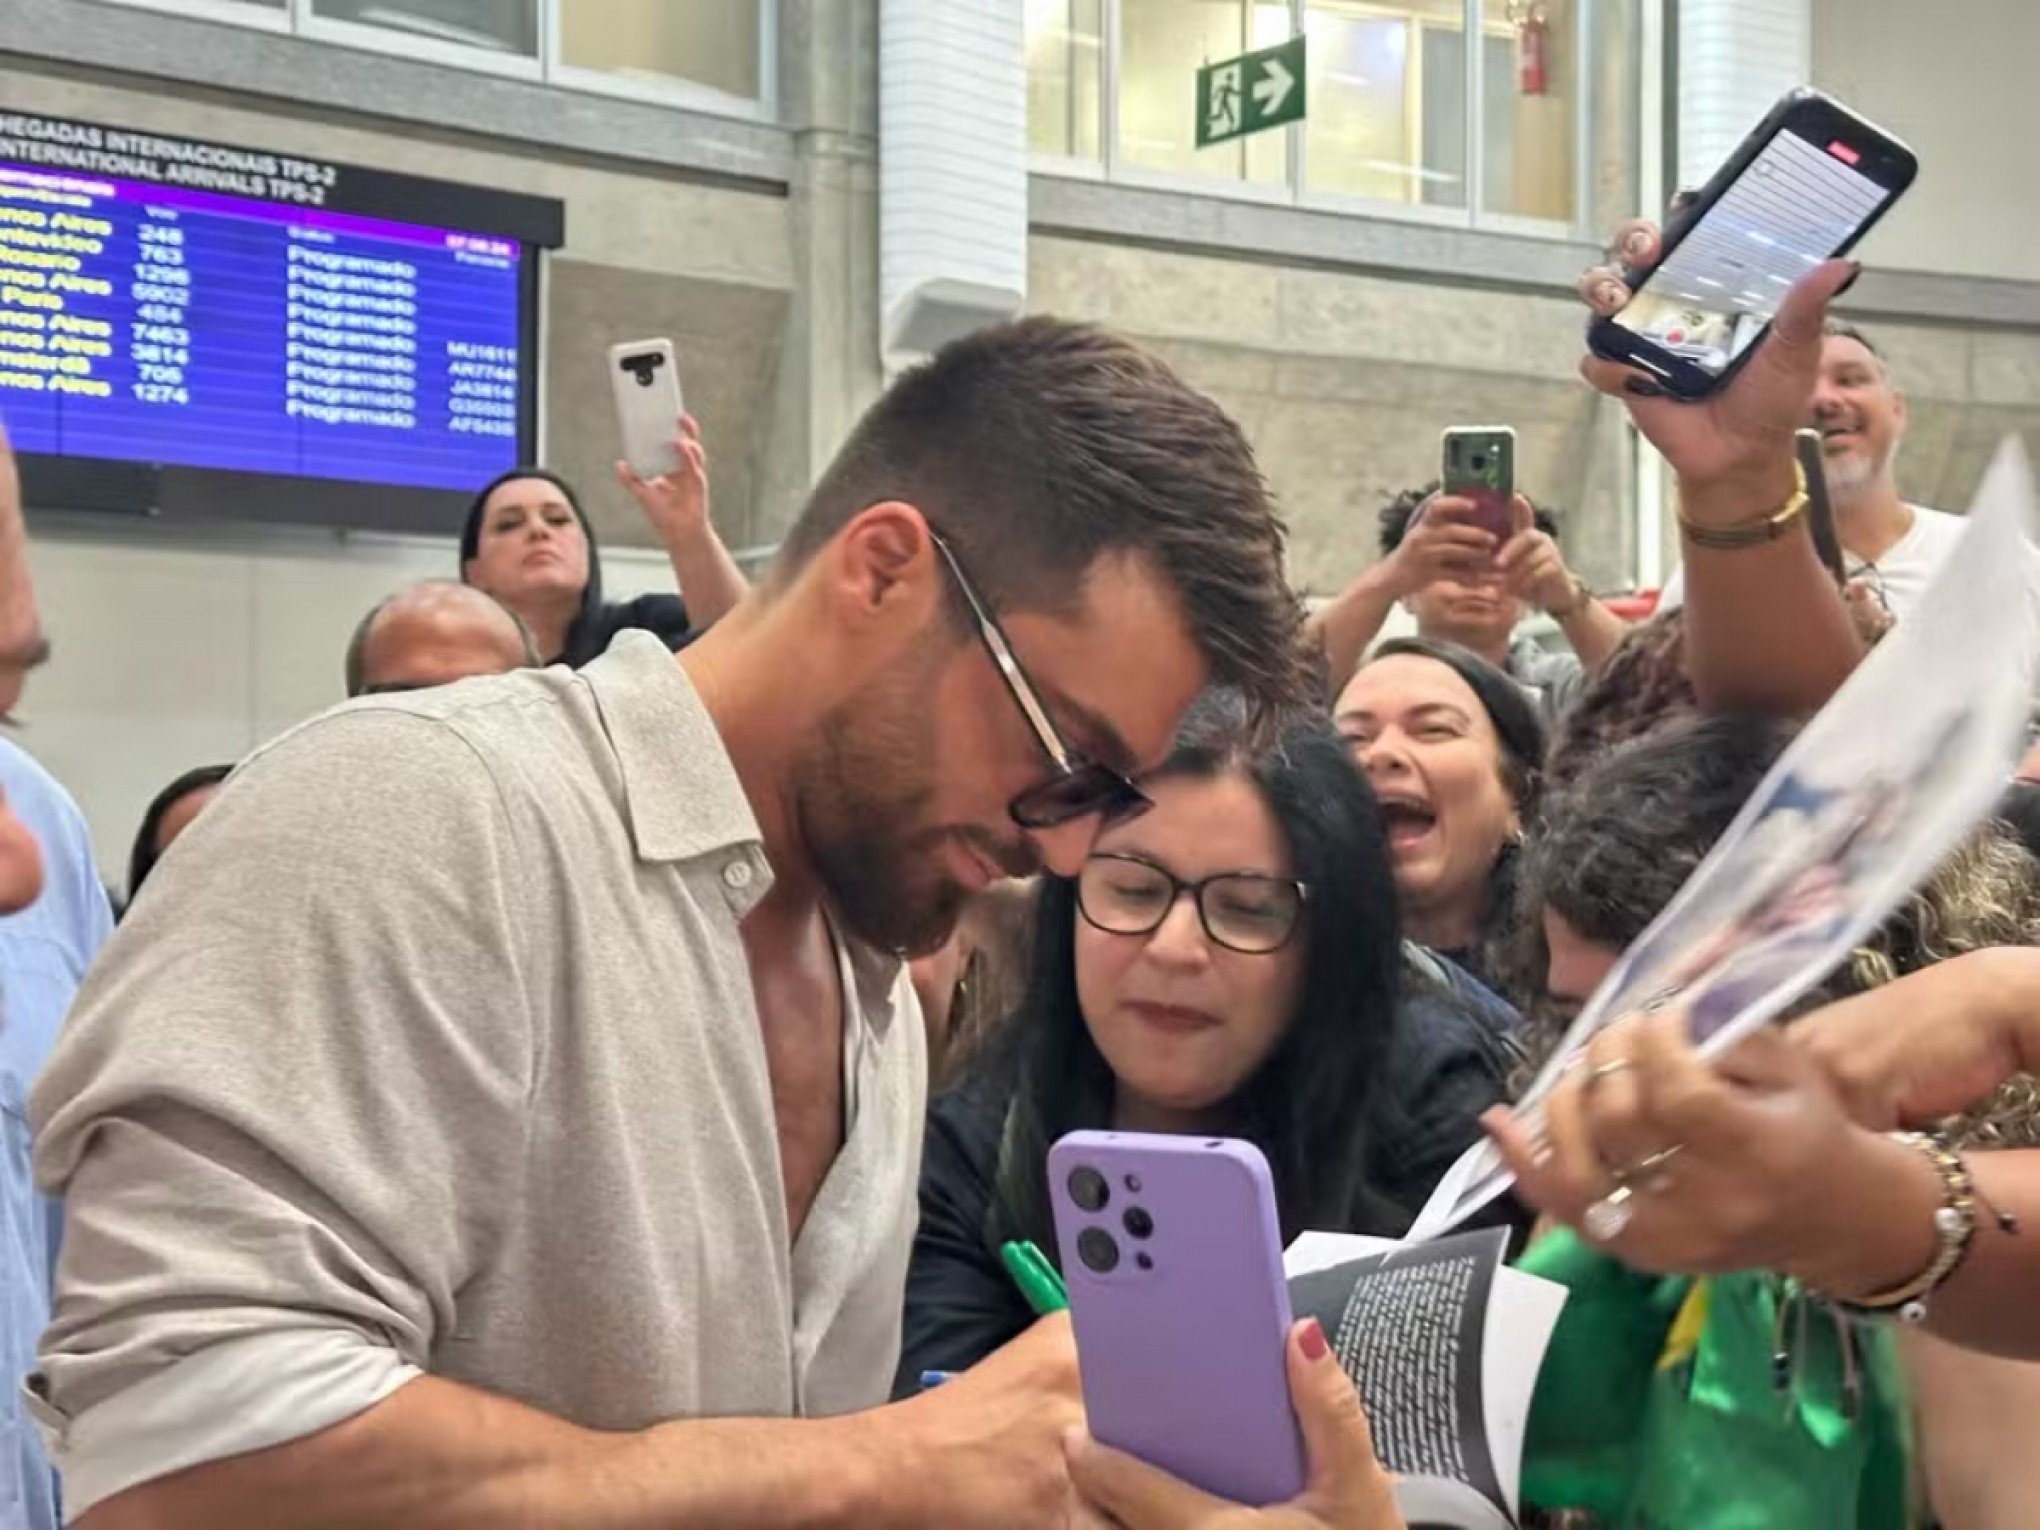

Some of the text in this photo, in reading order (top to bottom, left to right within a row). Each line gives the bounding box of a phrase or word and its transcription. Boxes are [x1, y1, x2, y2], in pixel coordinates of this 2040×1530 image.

[287, 245, 417, 278] Programado
[287, 264, 417, 297] Programado
[287, 284, 417, 317] Programado
[287, 303, 417, 335] Programado
[287, 322, 417, 353] Programado
[287, 341, 417, 372] Programado
[287, 360, 417, 390] Programado
[131, 383, 189, 404] 1274
[287, 399, 417, 428] Programado
[287, 379, 417, 409] Programado
